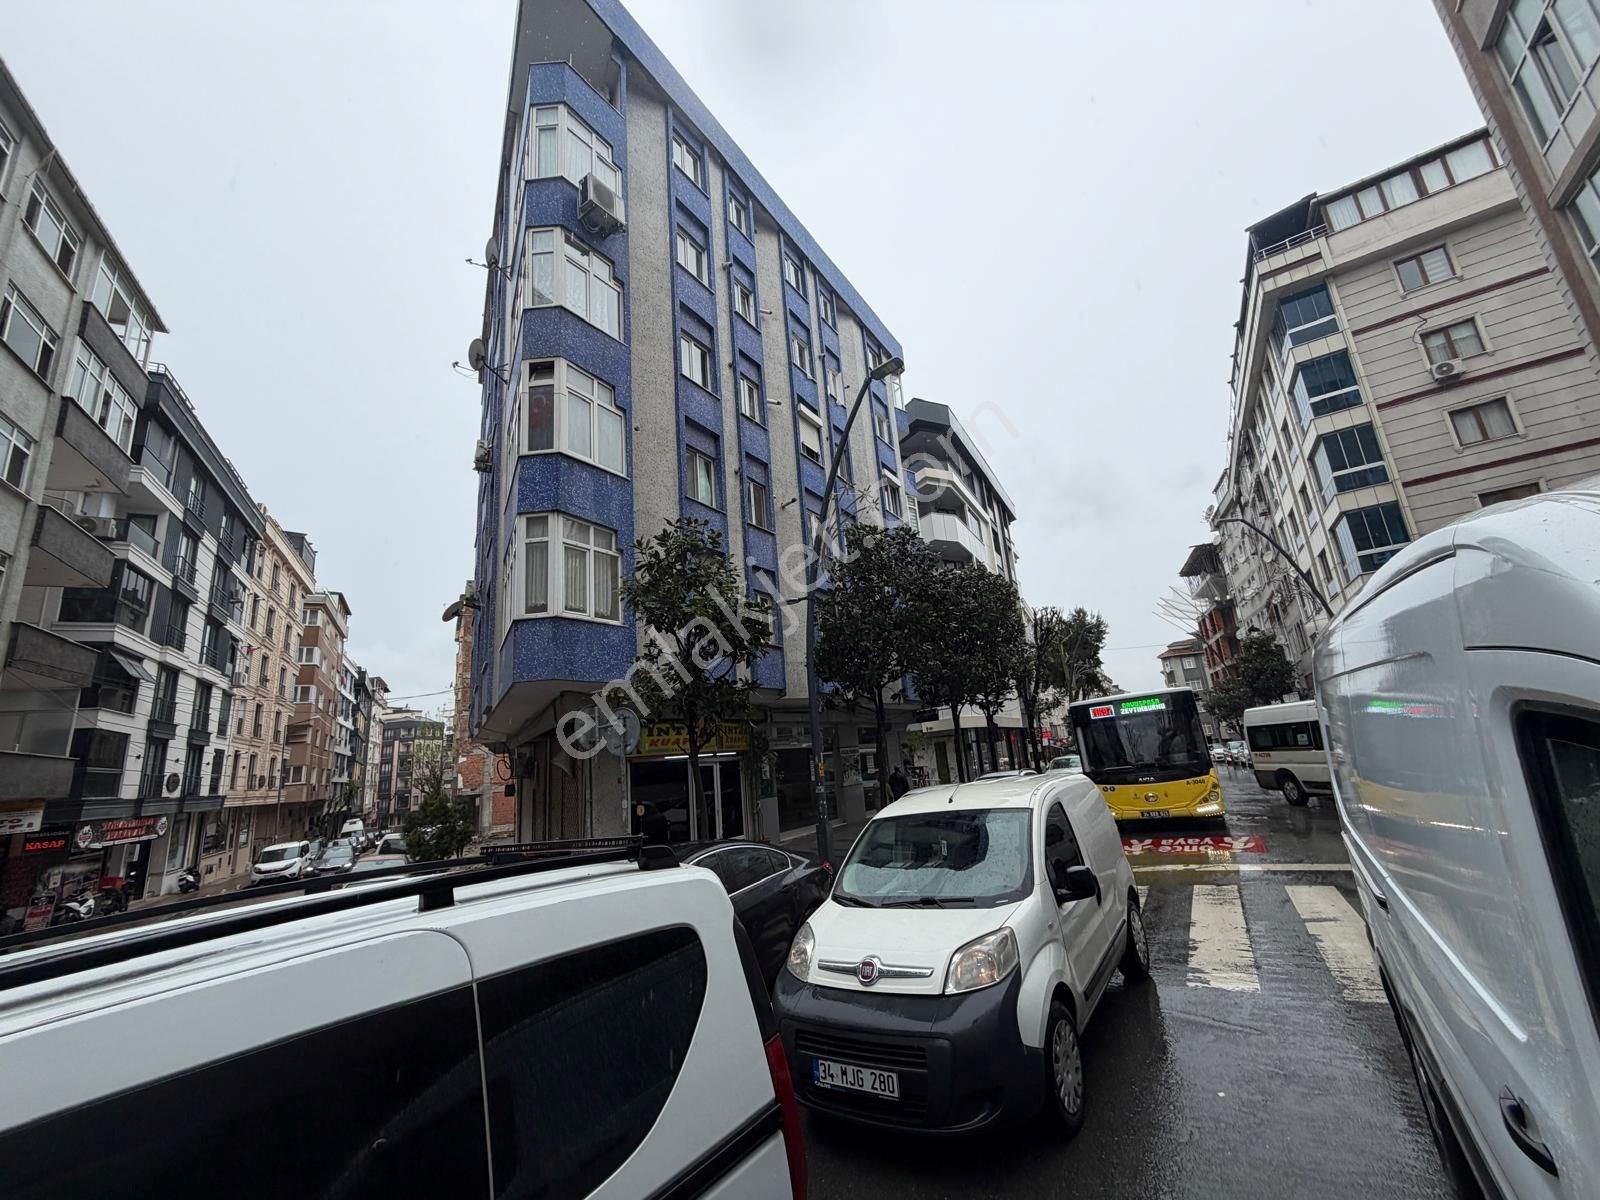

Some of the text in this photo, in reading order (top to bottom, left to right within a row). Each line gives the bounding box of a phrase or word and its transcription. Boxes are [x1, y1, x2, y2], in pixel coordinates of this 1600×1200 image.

[26, 840, 65, 850] KASAP
[1160, 837, 1214, 846] yaya
[861, 965, 873, 977] FIAT
[819, 1062, 834, 1082] 34
[840, 1066, 864, 1088] MJG
[870, 1072, 895, 1094] 280
